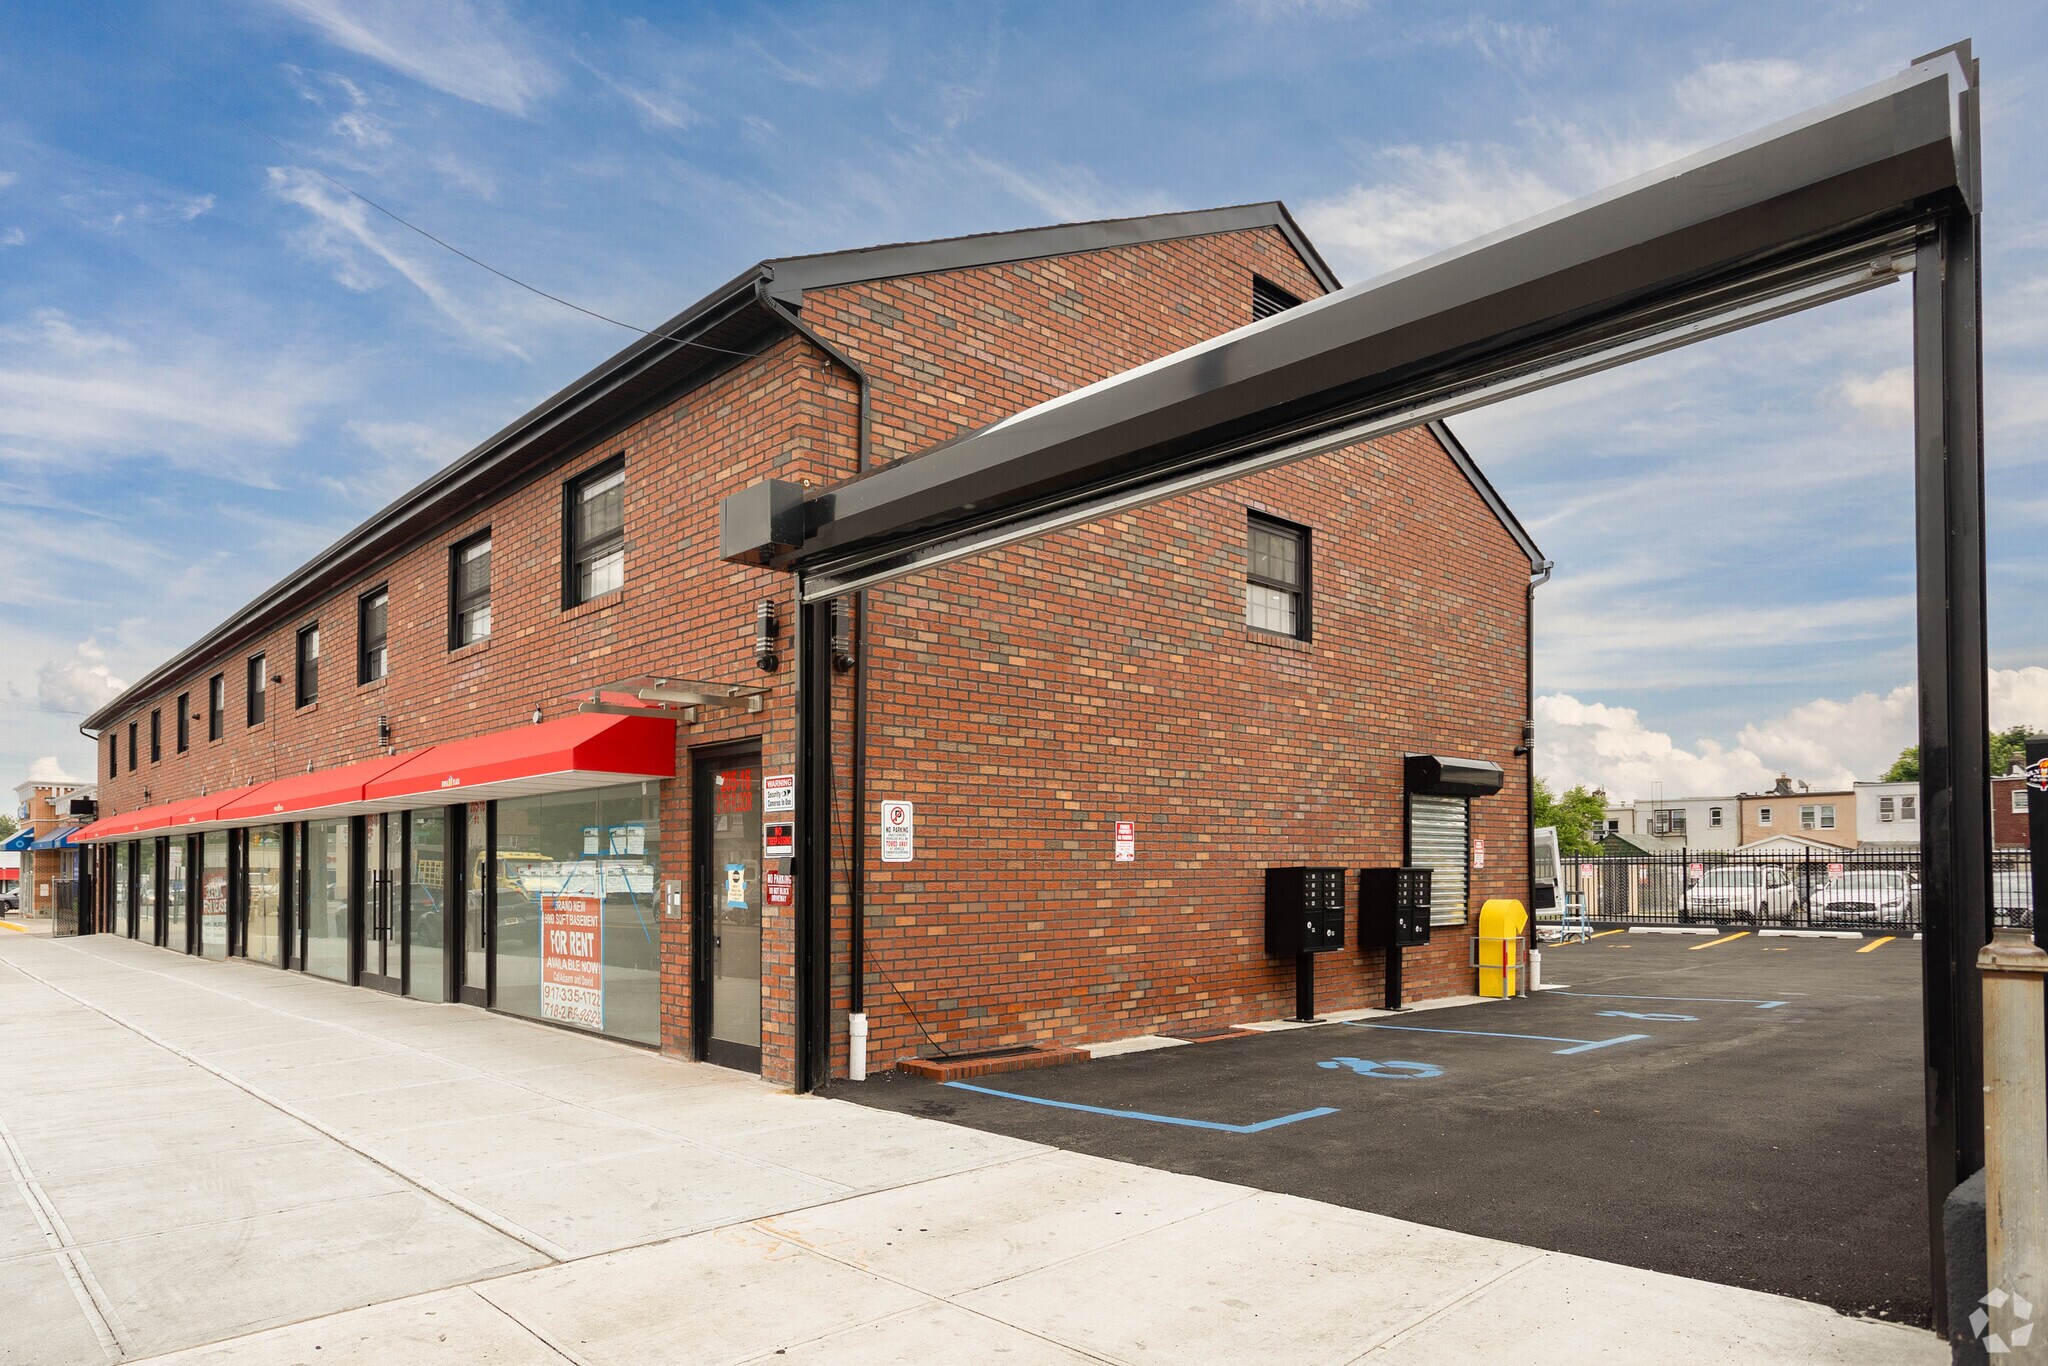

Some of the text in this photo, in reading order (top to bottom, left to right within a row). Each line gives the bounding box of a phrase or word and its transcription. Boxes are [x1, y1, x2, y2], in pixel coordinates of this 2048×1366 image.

[767, 779, 792, 788] WARNING
[767, 799, 781, 807] Cameras
[774, 826, 782, 836] NO
[767, 874, 792, 884] NO PARKING
[780, 887, 790, 895] BLOCK
[573, 901, 587, 912] NEW
[569, 914, 599, 927] BASEMENT
[550, 929, 594, 958] FOR RENT
[546, 956, 601, 975] AVAILABLE NOW!
